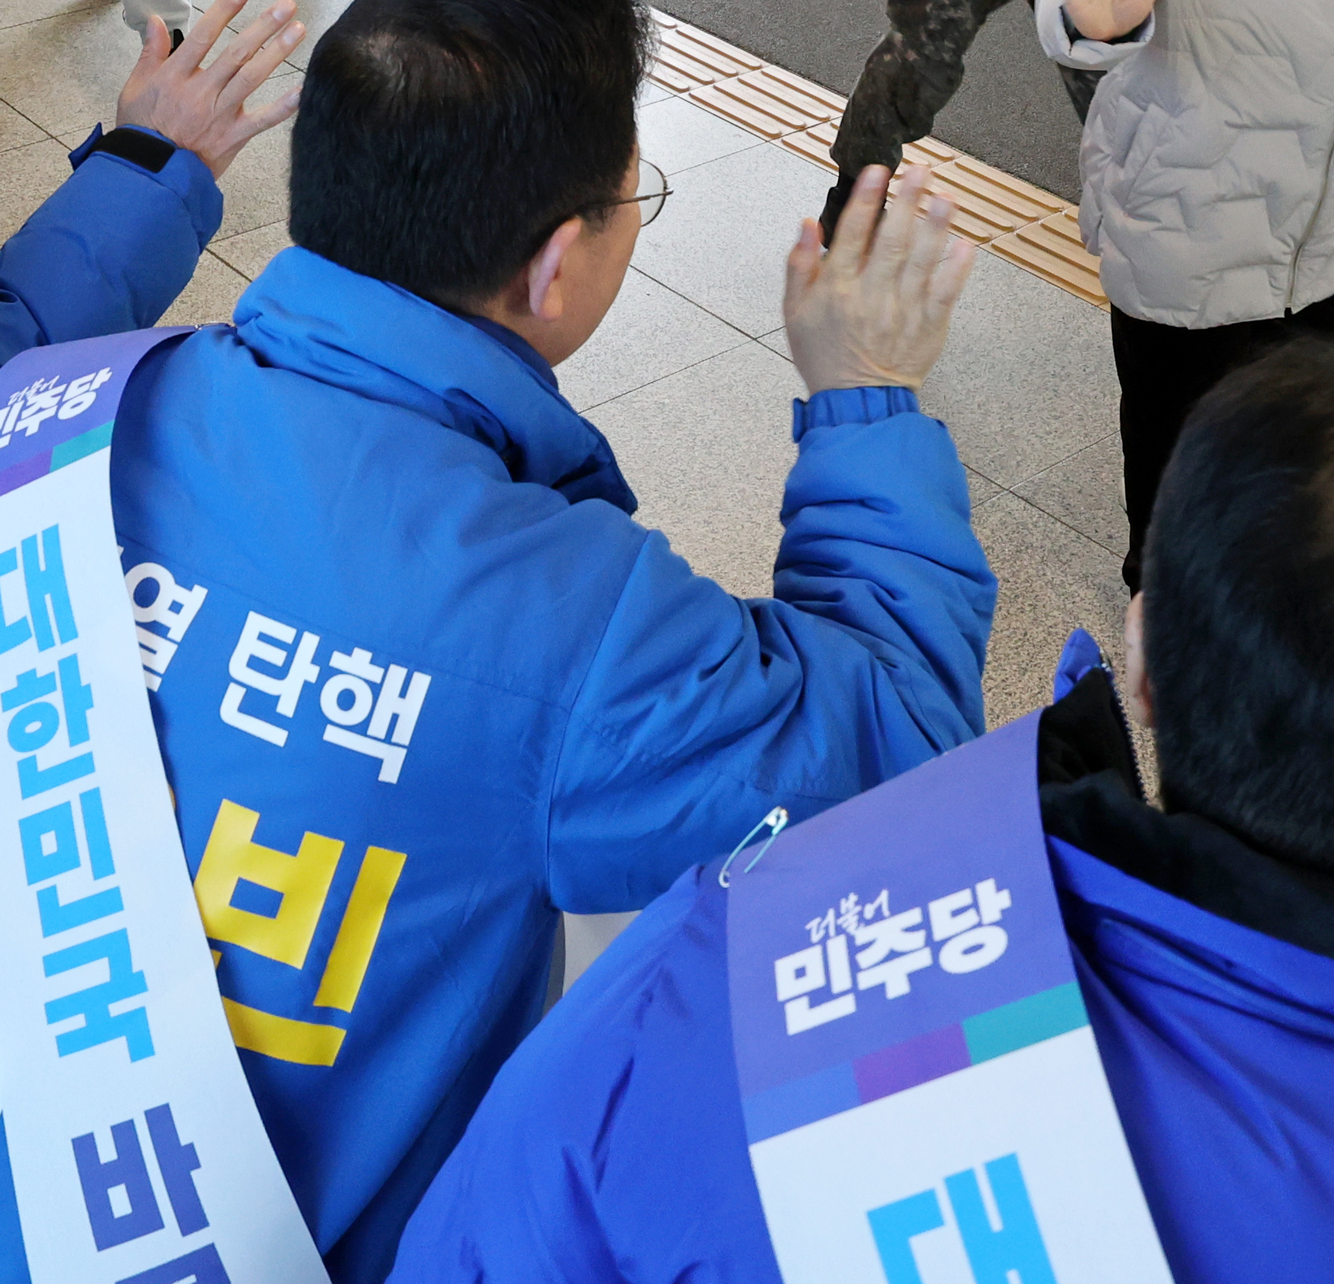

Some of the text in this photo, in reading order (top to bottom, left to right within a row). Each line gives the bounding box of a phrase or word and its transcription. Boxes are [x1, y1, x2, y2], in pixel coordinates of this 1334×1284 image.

[122, 554, 433, 786] 열 탄핵
[773, 877, 1013, 1037] 민주당
[803, 888, 892, 946] 더불어
[71, 1102, 234, 1284] 바
